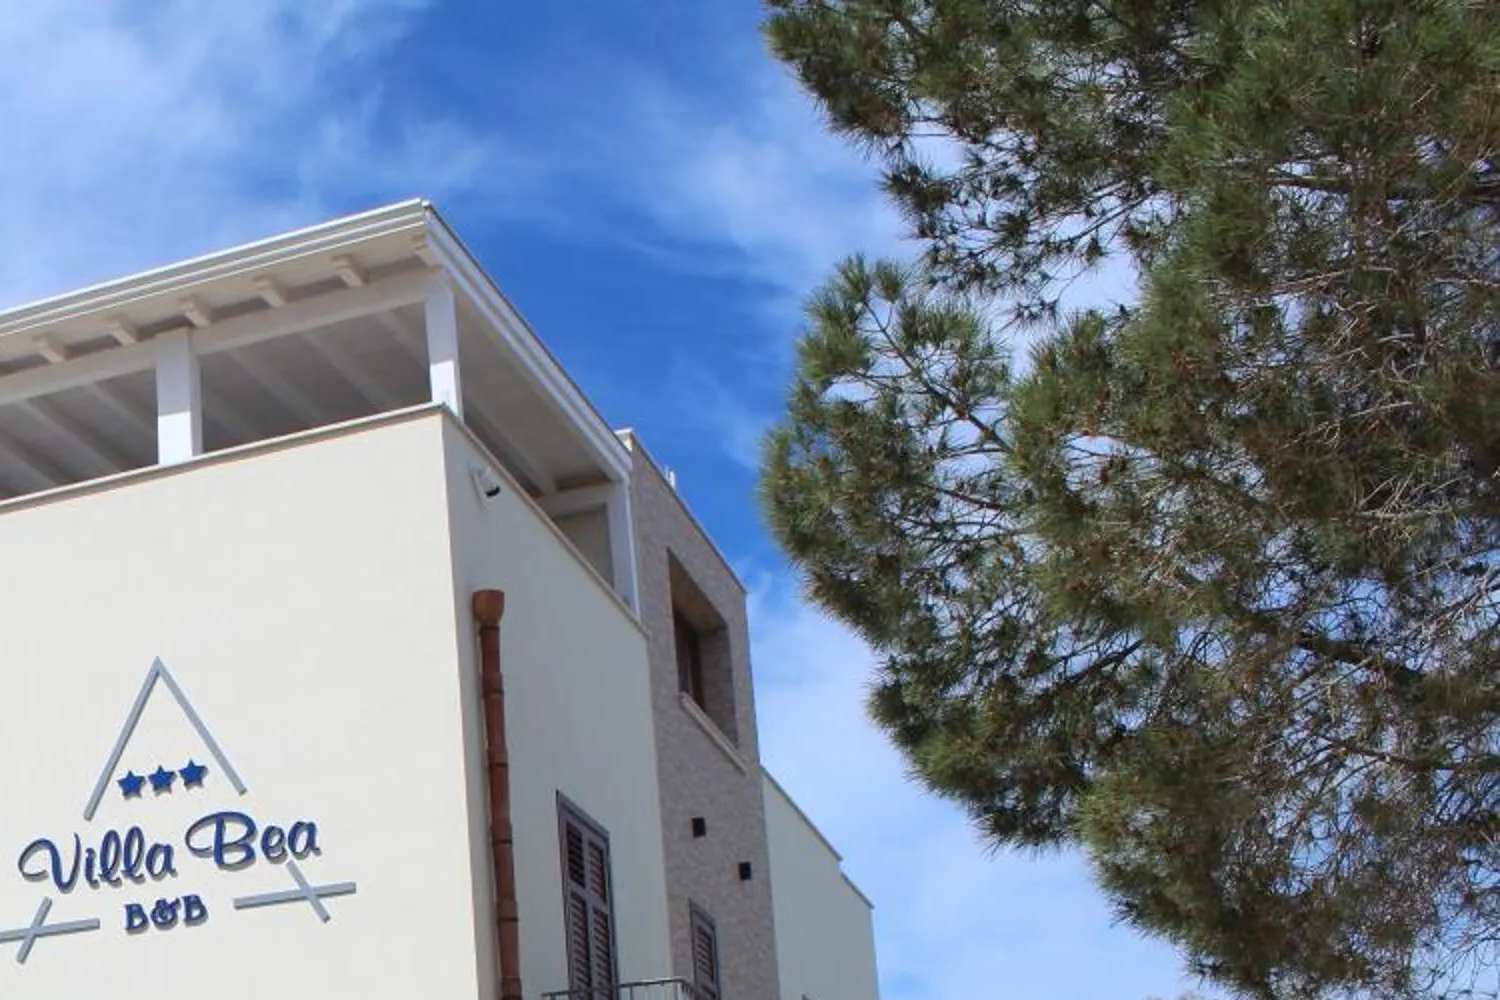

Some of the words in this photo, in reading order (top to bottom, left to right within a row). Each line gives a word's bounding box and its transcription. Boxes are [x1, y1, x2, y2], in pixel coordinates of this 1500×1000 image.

[18, 825, 178, 892] Villa
[185, 811, 321, 870] Bea
[124, 893, 209, 933] B&B
